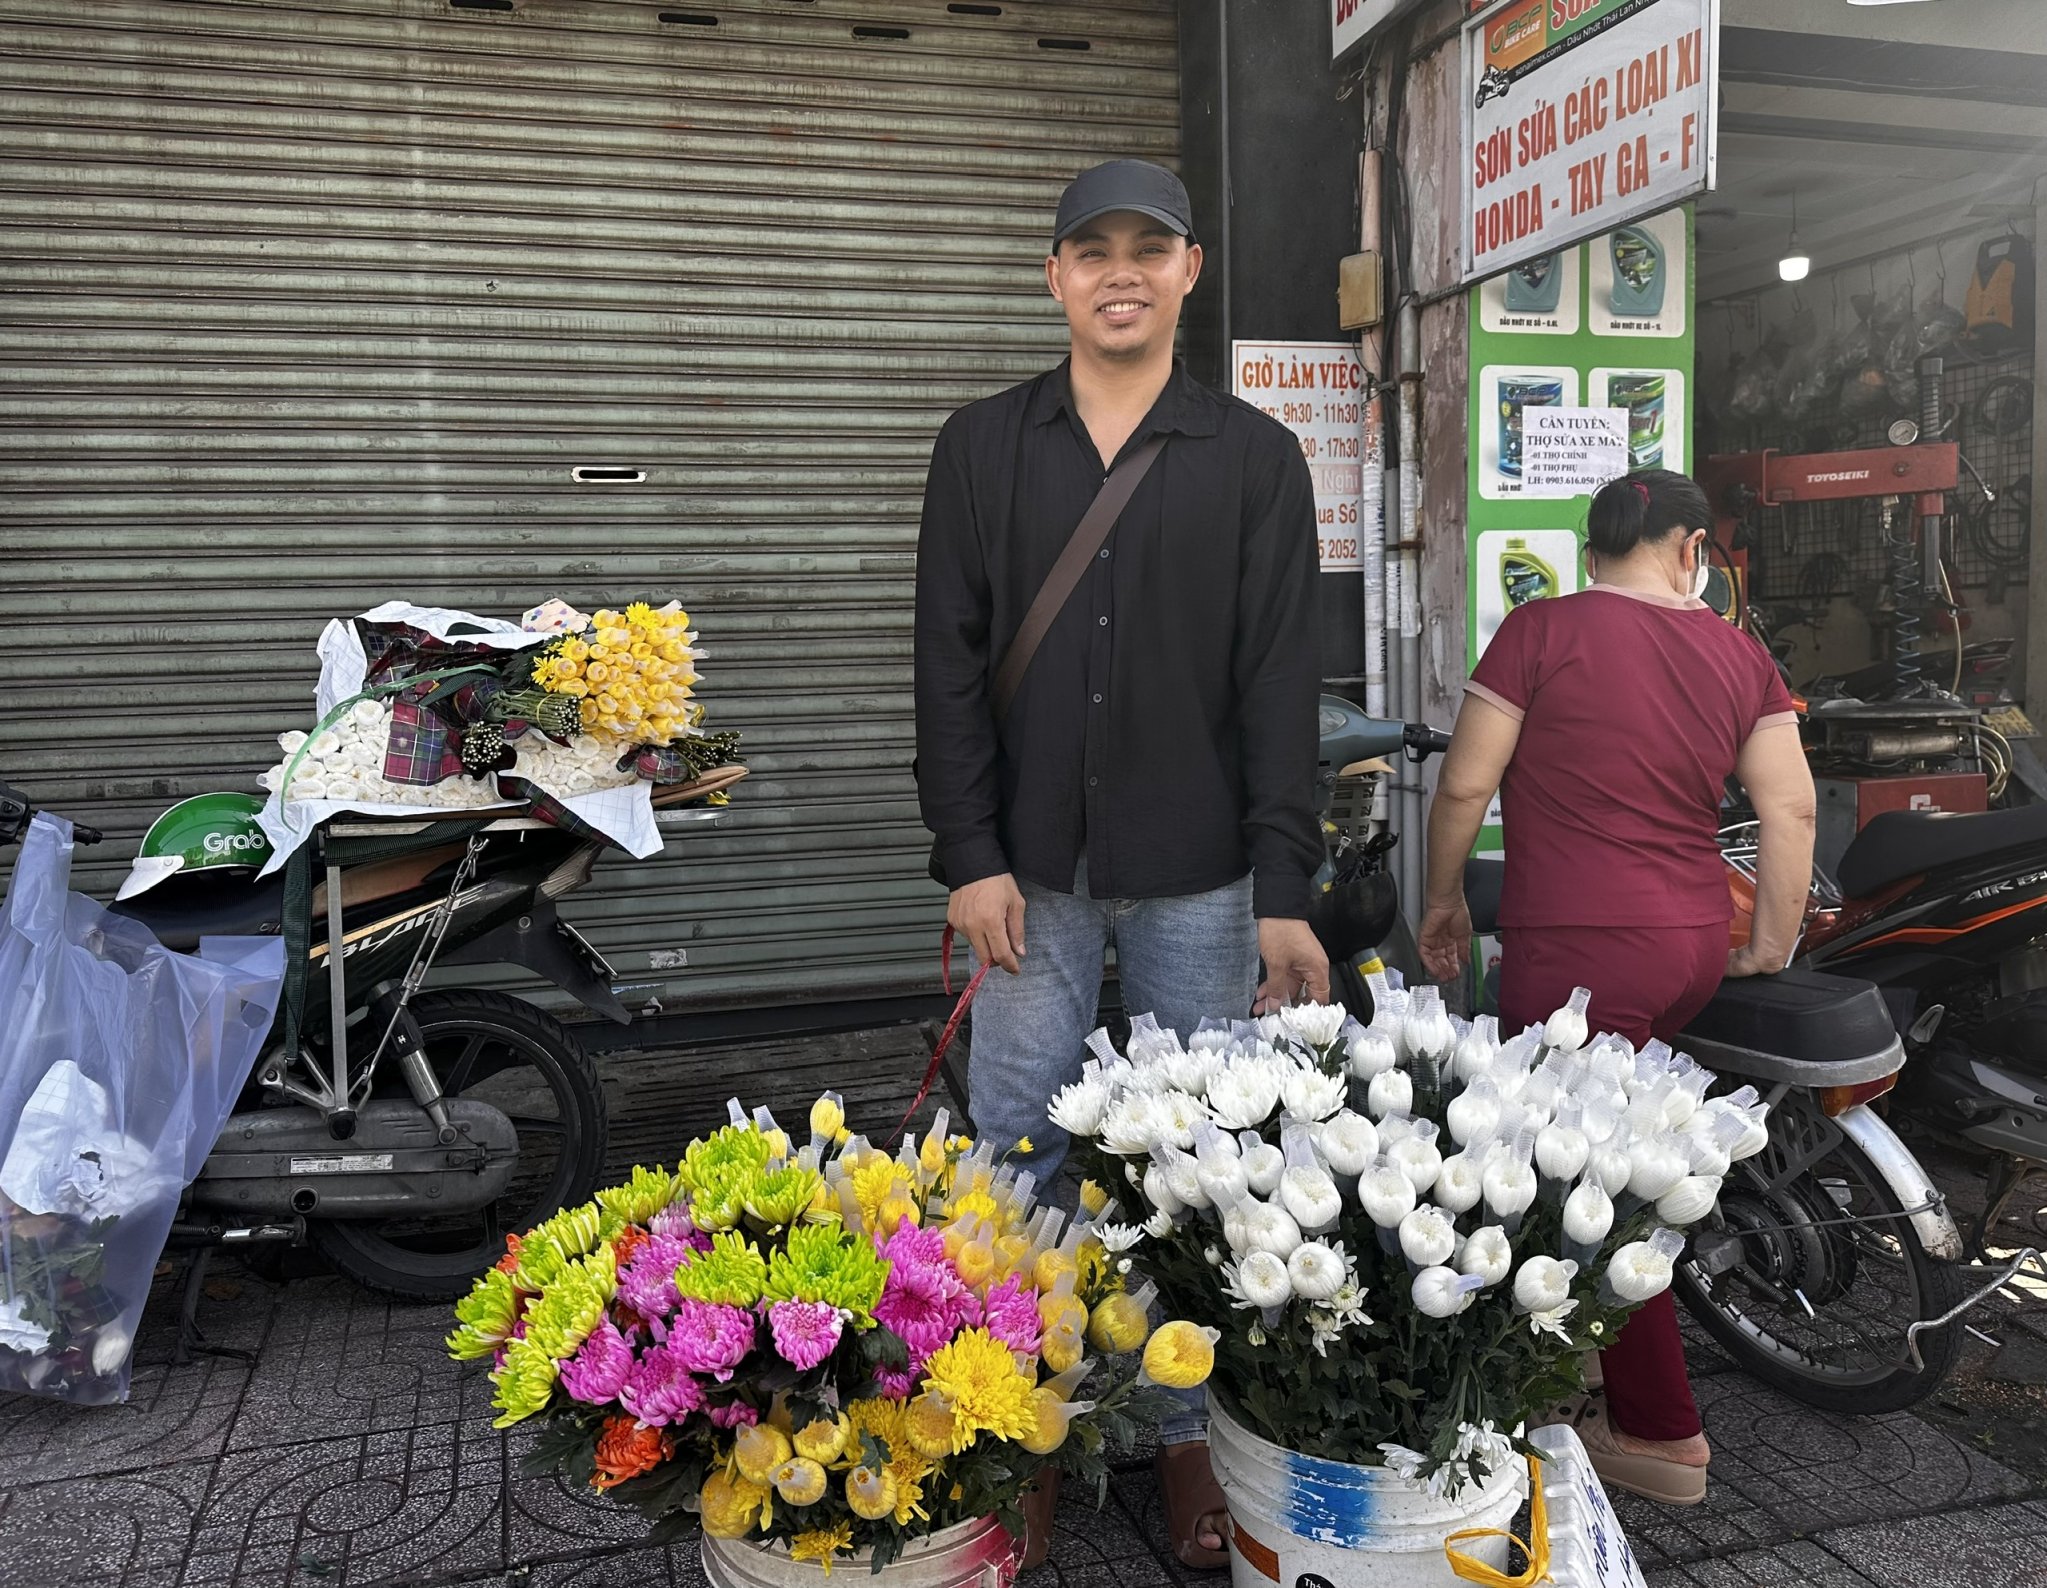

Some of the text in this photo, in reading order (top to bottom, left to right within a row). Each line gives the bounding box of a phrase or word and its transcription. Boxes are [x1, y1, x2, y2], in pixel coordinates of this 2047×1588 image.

[1619, 4, 1633, 17] Lan
[1521, 20, 1541, 38] CARE
[1475, 126, 1512, 189] SƠN
[1517, 98, 1558, 167] SỬA
[1564, 77, 1608, 146] CÁC
[1615, 44, 1669, 121] LOẠI
[1475, 183, 1544, 257] HONDA
[1568, 152, 1607, 217] TAY
[1616, 134, 1650, 198] GA
[1242, 353, 1361, 397] GIỜ LÀM VIỆC
[1283, 402, 1313, 424] 9h30
[1323, 402, 1359, 424] 11h30
[1540, 415, 1565, 429] CẦN
[1326, 437, 1360, 458] 17h30
[1526, 434, 1552, 449] THỢ
[1554, 433, 1577, 446] SỬA
[1580, 436, 1596, 447] XE
[1543, 463, 1561, 474] THỢ
[1806, 470, 1870, 484] TOYOSEIKI
[1527, 475, 1544, 485] LH:
[1338, 500, 1358, 524] Số
[1328, 538, 1358, 559] 2052
[203, 829, 265, 852] Grab
[1959, 879, 2015, 905] AIR
